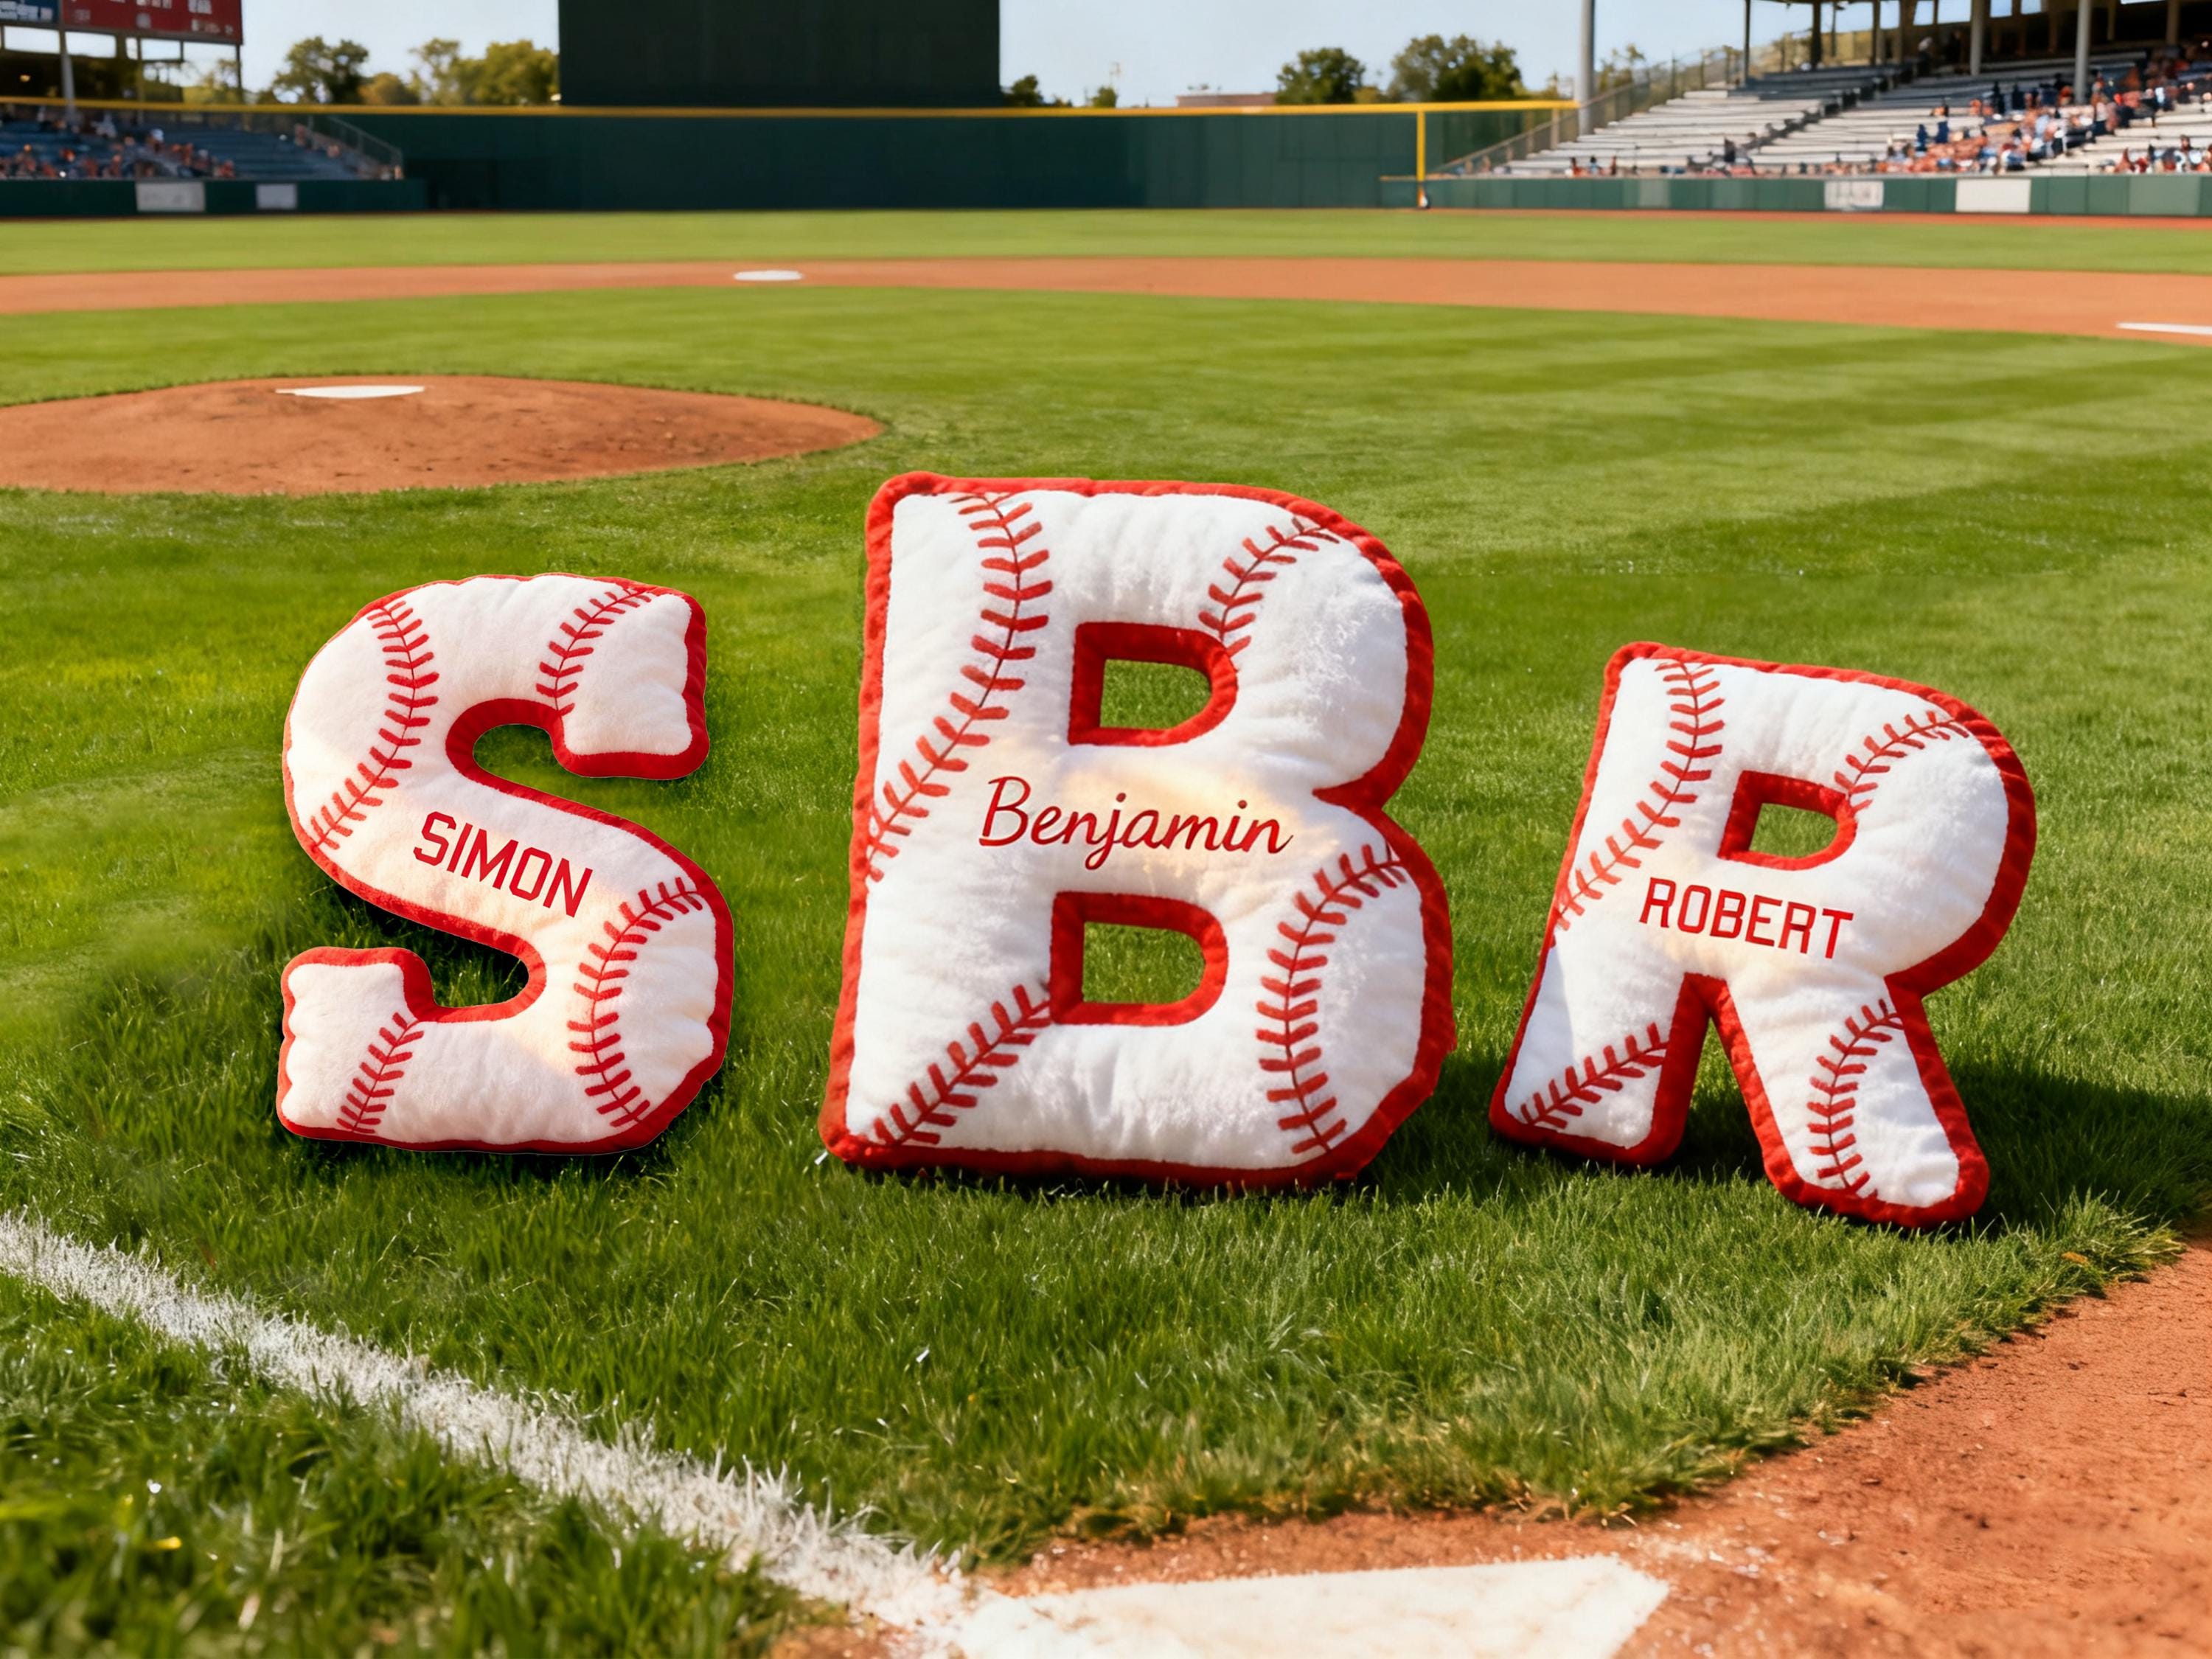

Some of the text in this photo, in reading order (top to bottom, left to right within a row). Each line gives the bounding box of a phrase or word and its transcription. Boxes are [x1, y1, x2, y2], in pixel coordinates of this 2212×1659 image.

[413, 811, 594, 918] SIMON
[978, 776, 1293, 871] Benjamin
[1639, 877, 1854, 959] ROBERT
